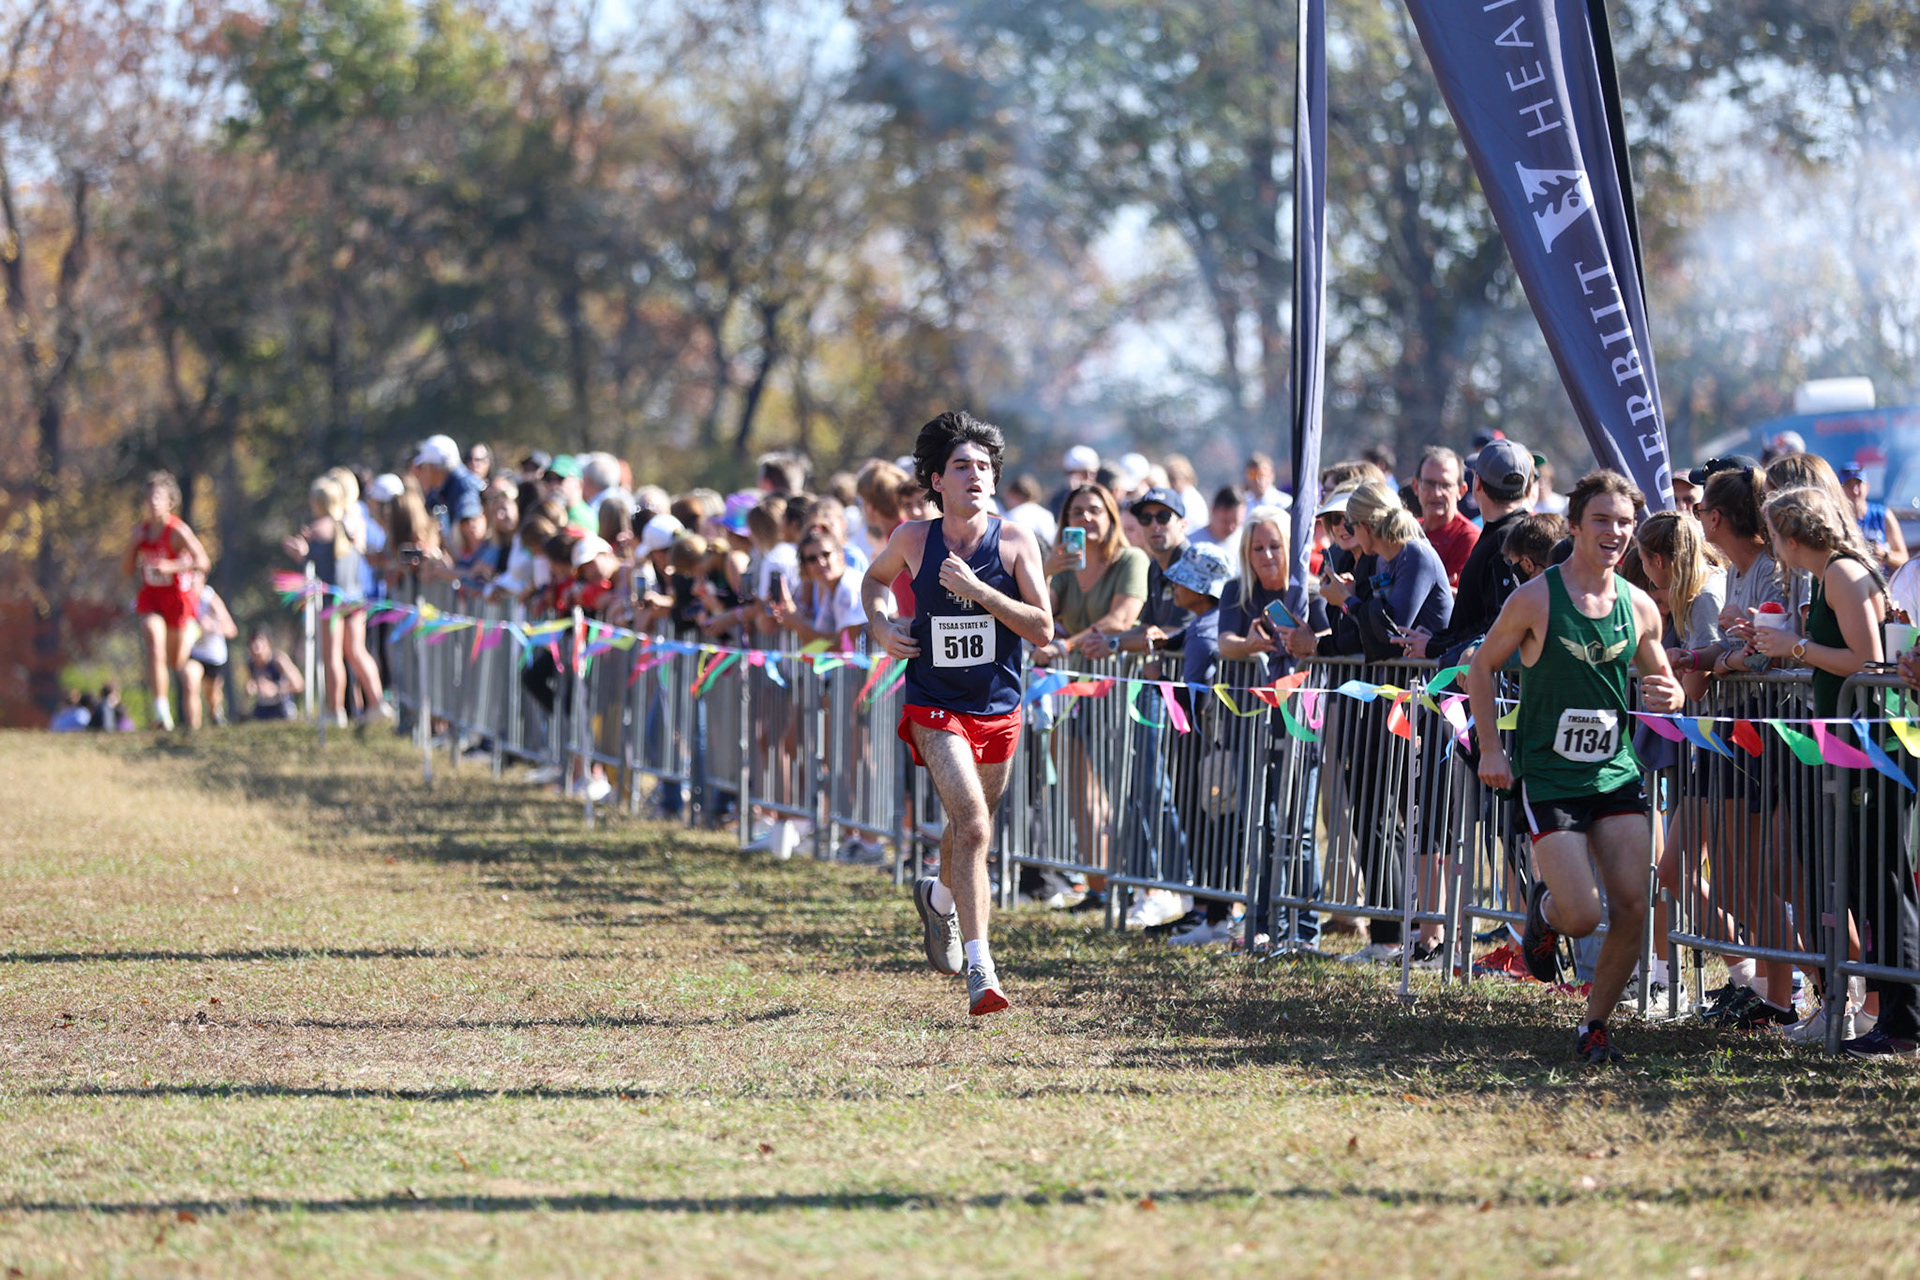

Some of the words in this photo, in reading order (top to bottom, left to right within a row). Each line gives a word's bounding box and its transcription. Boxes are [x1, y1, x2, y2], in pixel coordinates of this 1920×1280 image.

[938, 622, 959, 630] TSSAA
[960, 622, 978, 630] STATE
[979, 621, 988, 629] XC
[944, 634, 984, 660] 518
[1563, 728, 1612, 754] 1134
